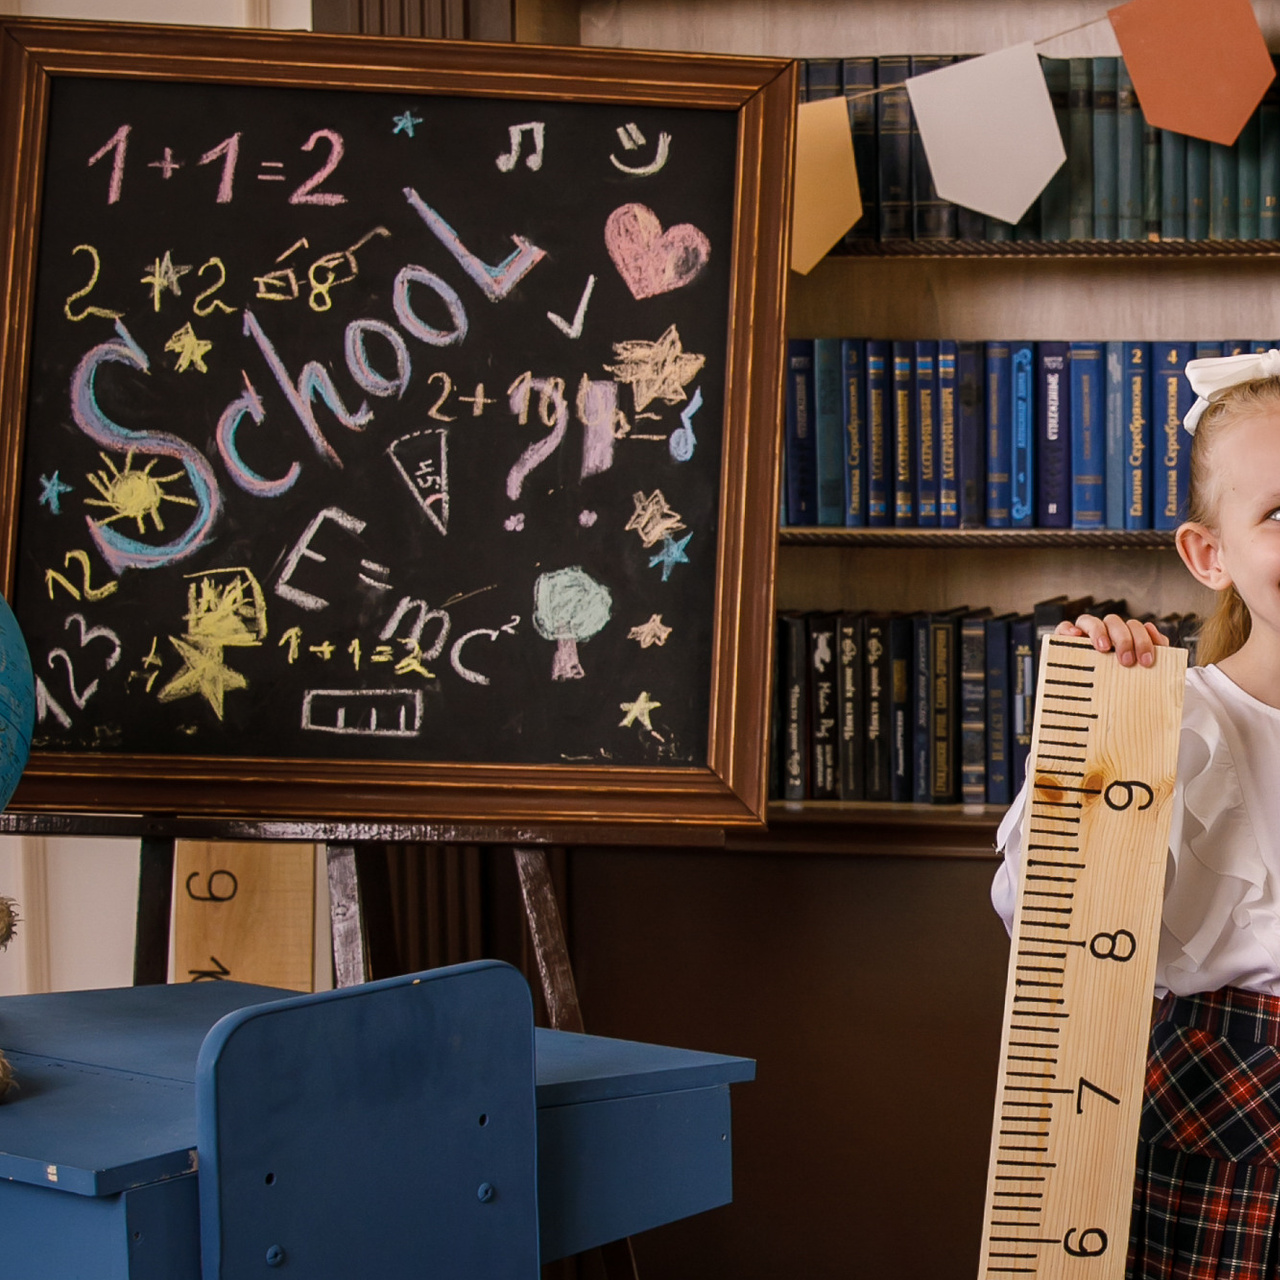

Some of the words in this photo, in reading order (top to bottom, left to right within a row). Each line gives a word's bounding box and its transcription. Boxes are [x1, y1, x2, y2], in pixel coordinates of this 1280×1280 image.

[1132, 349, 1143, 364] 2
[1167, 349, 1178, 365] 4
[1128, 376, 1146, 467] Серебрякова
[1163, 377, 1180, 467] Серебрякова
[1129, 469, 1143, 517] Галина
[1163, 470, 1177, 517] Галина
[1103, 780, 1154, 811] 9
[1089, 928, 1137, 963] 8
[1076, 1076, 1121, 1115] 7
[1063, 1227, 1108, 1258] 6
